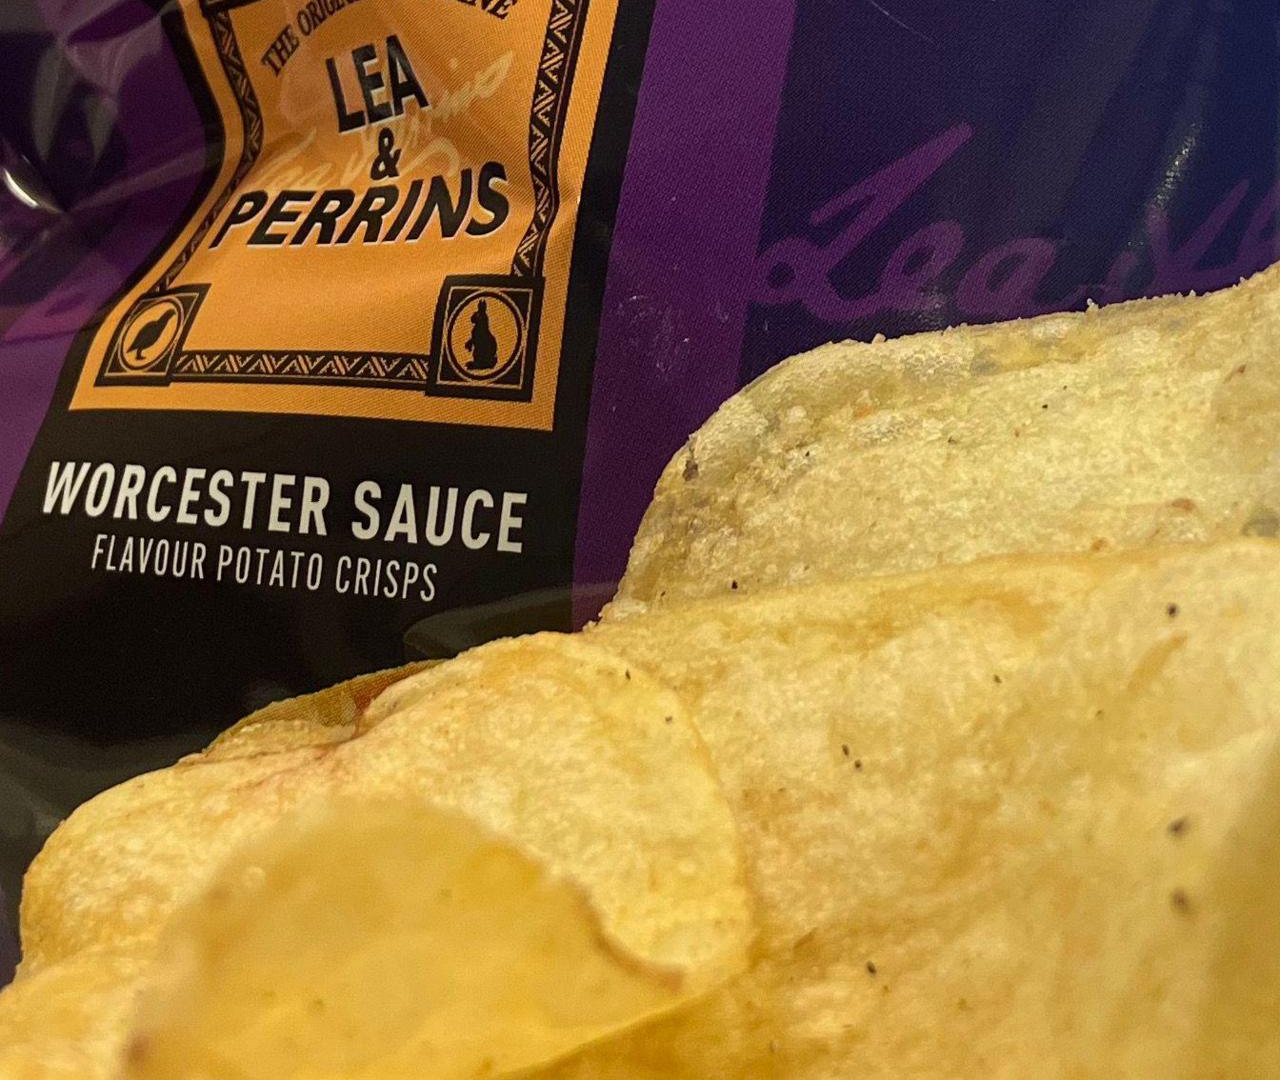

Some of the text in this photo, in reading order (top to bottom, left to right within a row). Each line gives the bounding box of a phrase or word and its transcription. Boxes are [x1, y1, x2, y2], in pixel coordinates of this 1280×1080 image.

[261, 24, 300, 77] THE
[325, 34, 429, 131] LEA
[370, 128, 402, 181] &
[209, 161, 511, 250] PERRINS
[745, 123, 1070, 317] Lea
[42, 461, 528, 553] WORCESTER SAUCE
[90, 533, 438, 602] FLAVOUR POTATO CRISPS
